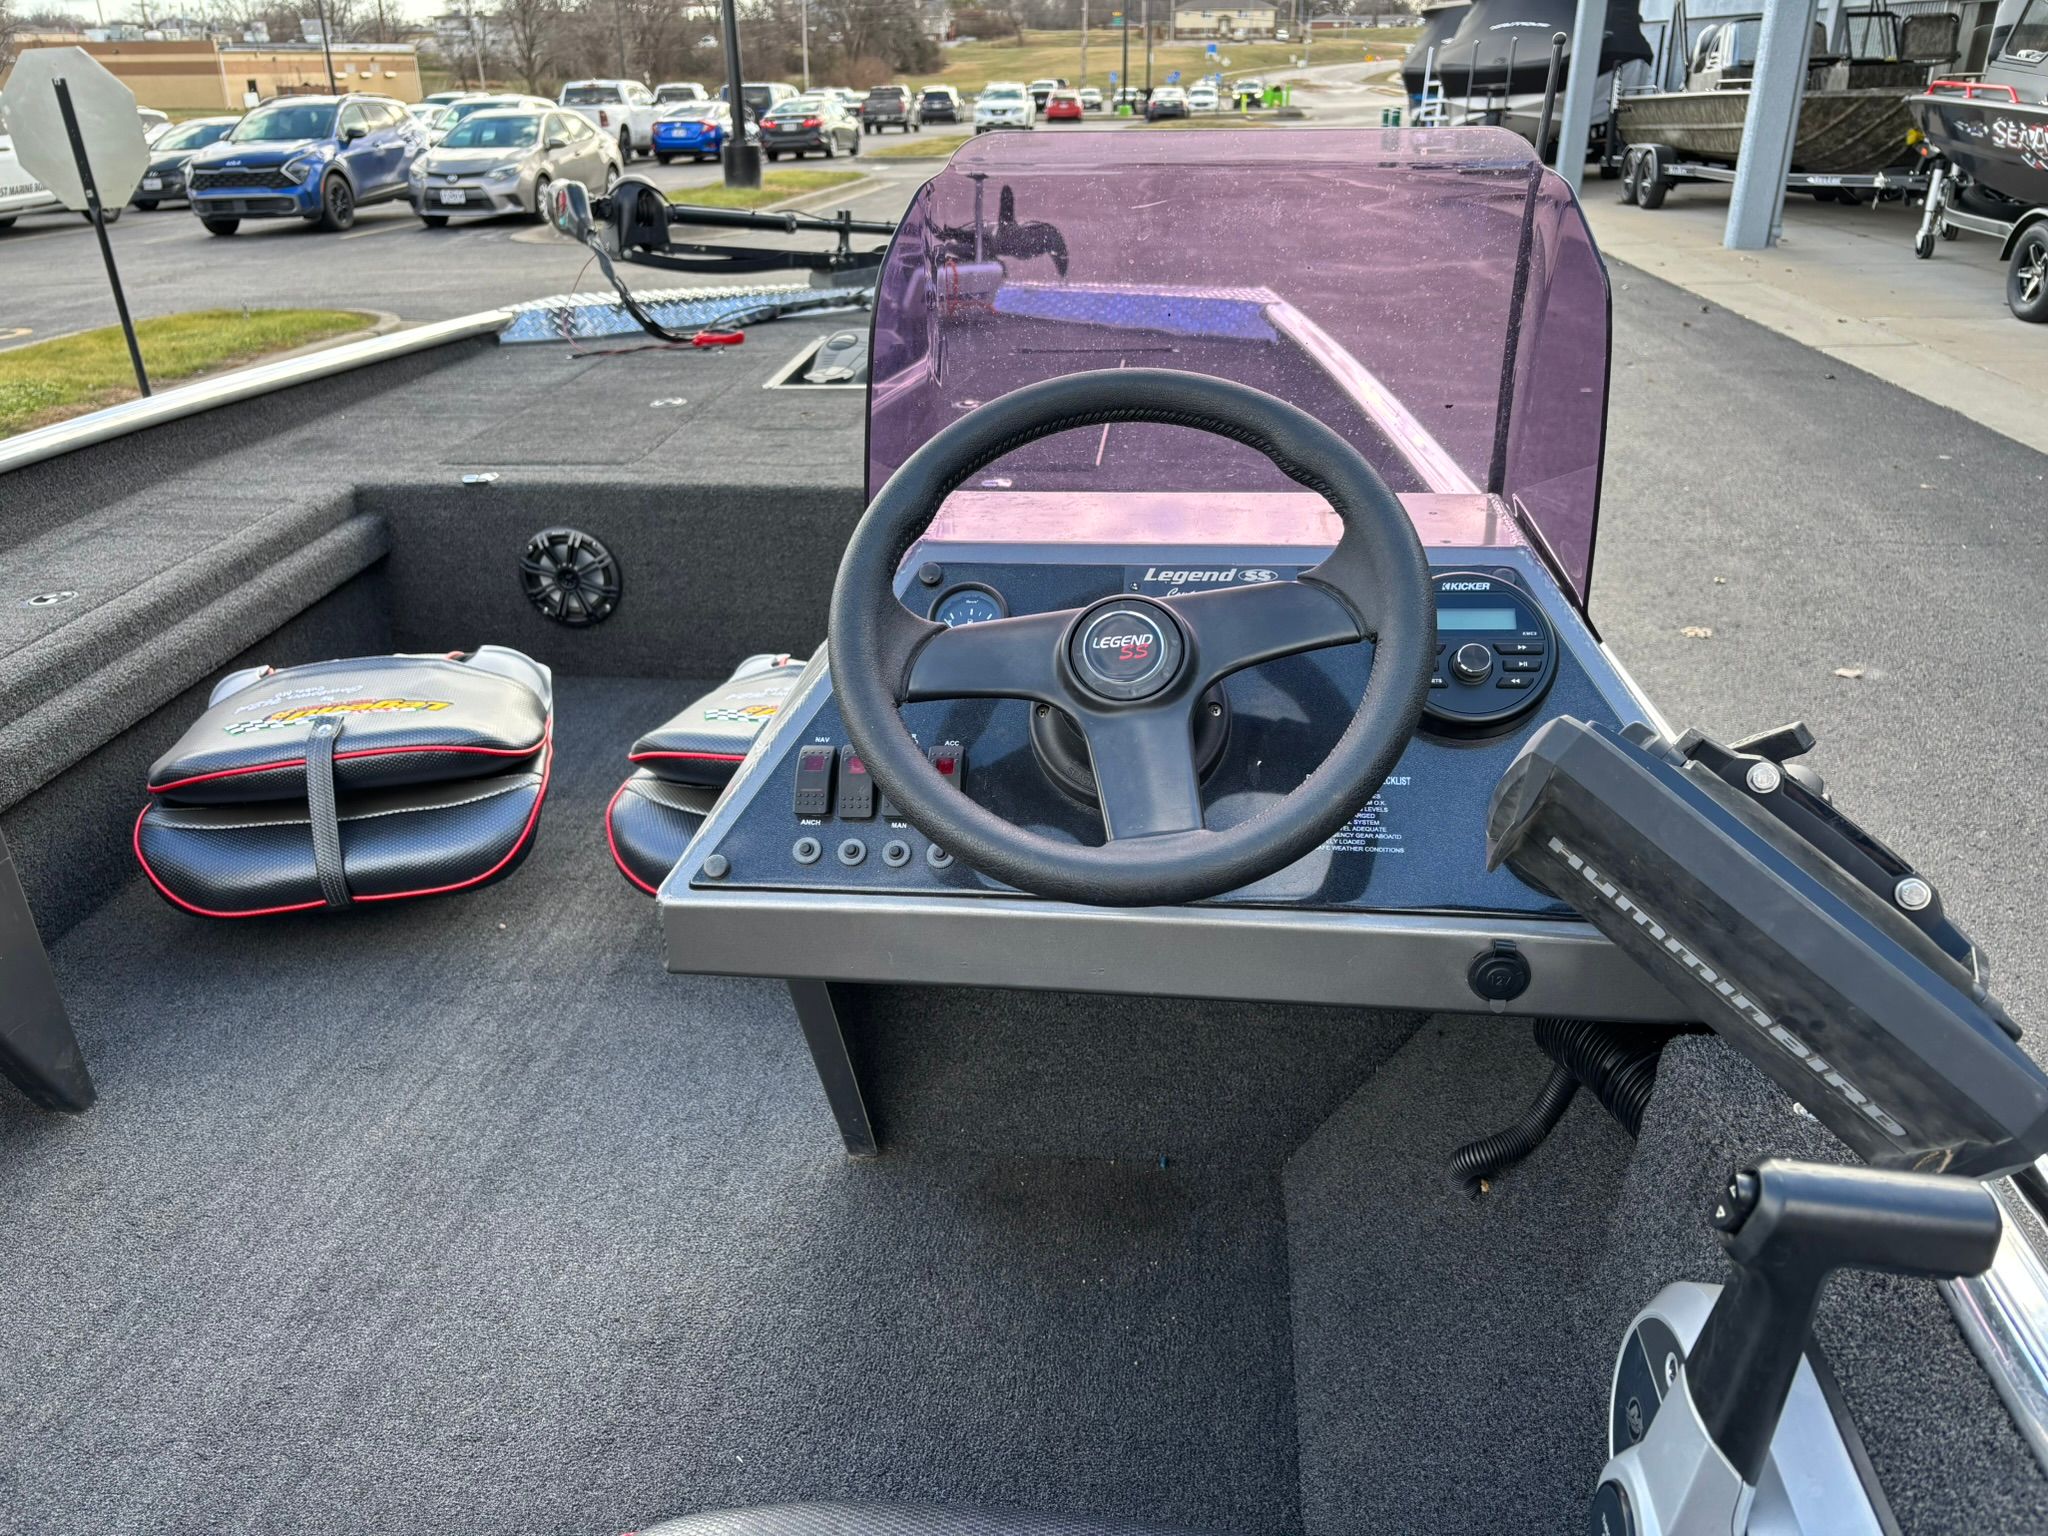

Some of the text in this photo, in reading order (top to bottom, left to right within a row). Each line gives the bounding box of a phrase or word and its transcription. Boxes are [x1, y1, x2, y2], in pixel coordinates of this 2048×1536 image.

[10, 182, 34, 195] MARINE
[1144, 568, 1237, 584] Legend
[1451, 582, 1490, 591] KICKER
[1093, 634, 1153, 649] LEGEND
[1119, 644, 1150, 660] SS
